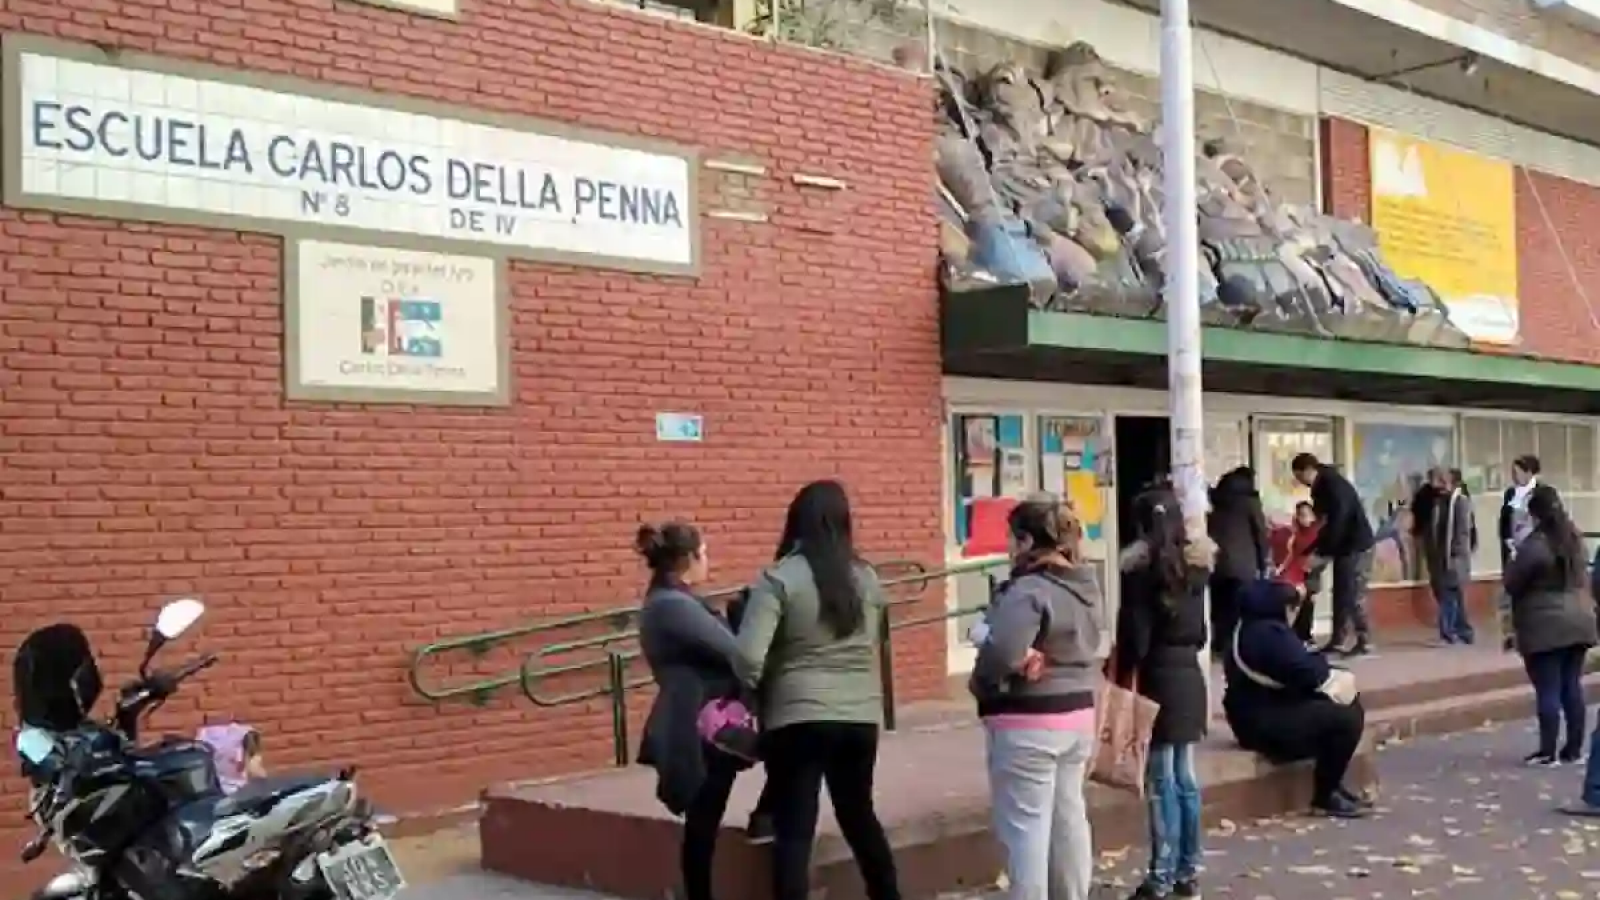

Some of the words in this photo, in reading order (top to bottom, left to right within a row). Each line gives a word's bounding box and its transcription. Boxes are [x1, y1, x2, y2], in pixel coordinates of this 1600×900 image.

[33, 100, 253, 172] ESCUELA
[267, 135, 432, 194] CARLOS
[447, 158, 562, 213] DELLA
[574, 177, 683, 228] PENNA
[334, 193, 351, 217] 8
[450, 208, 485, 232] DE
[496, 214, 517, 236] IV
